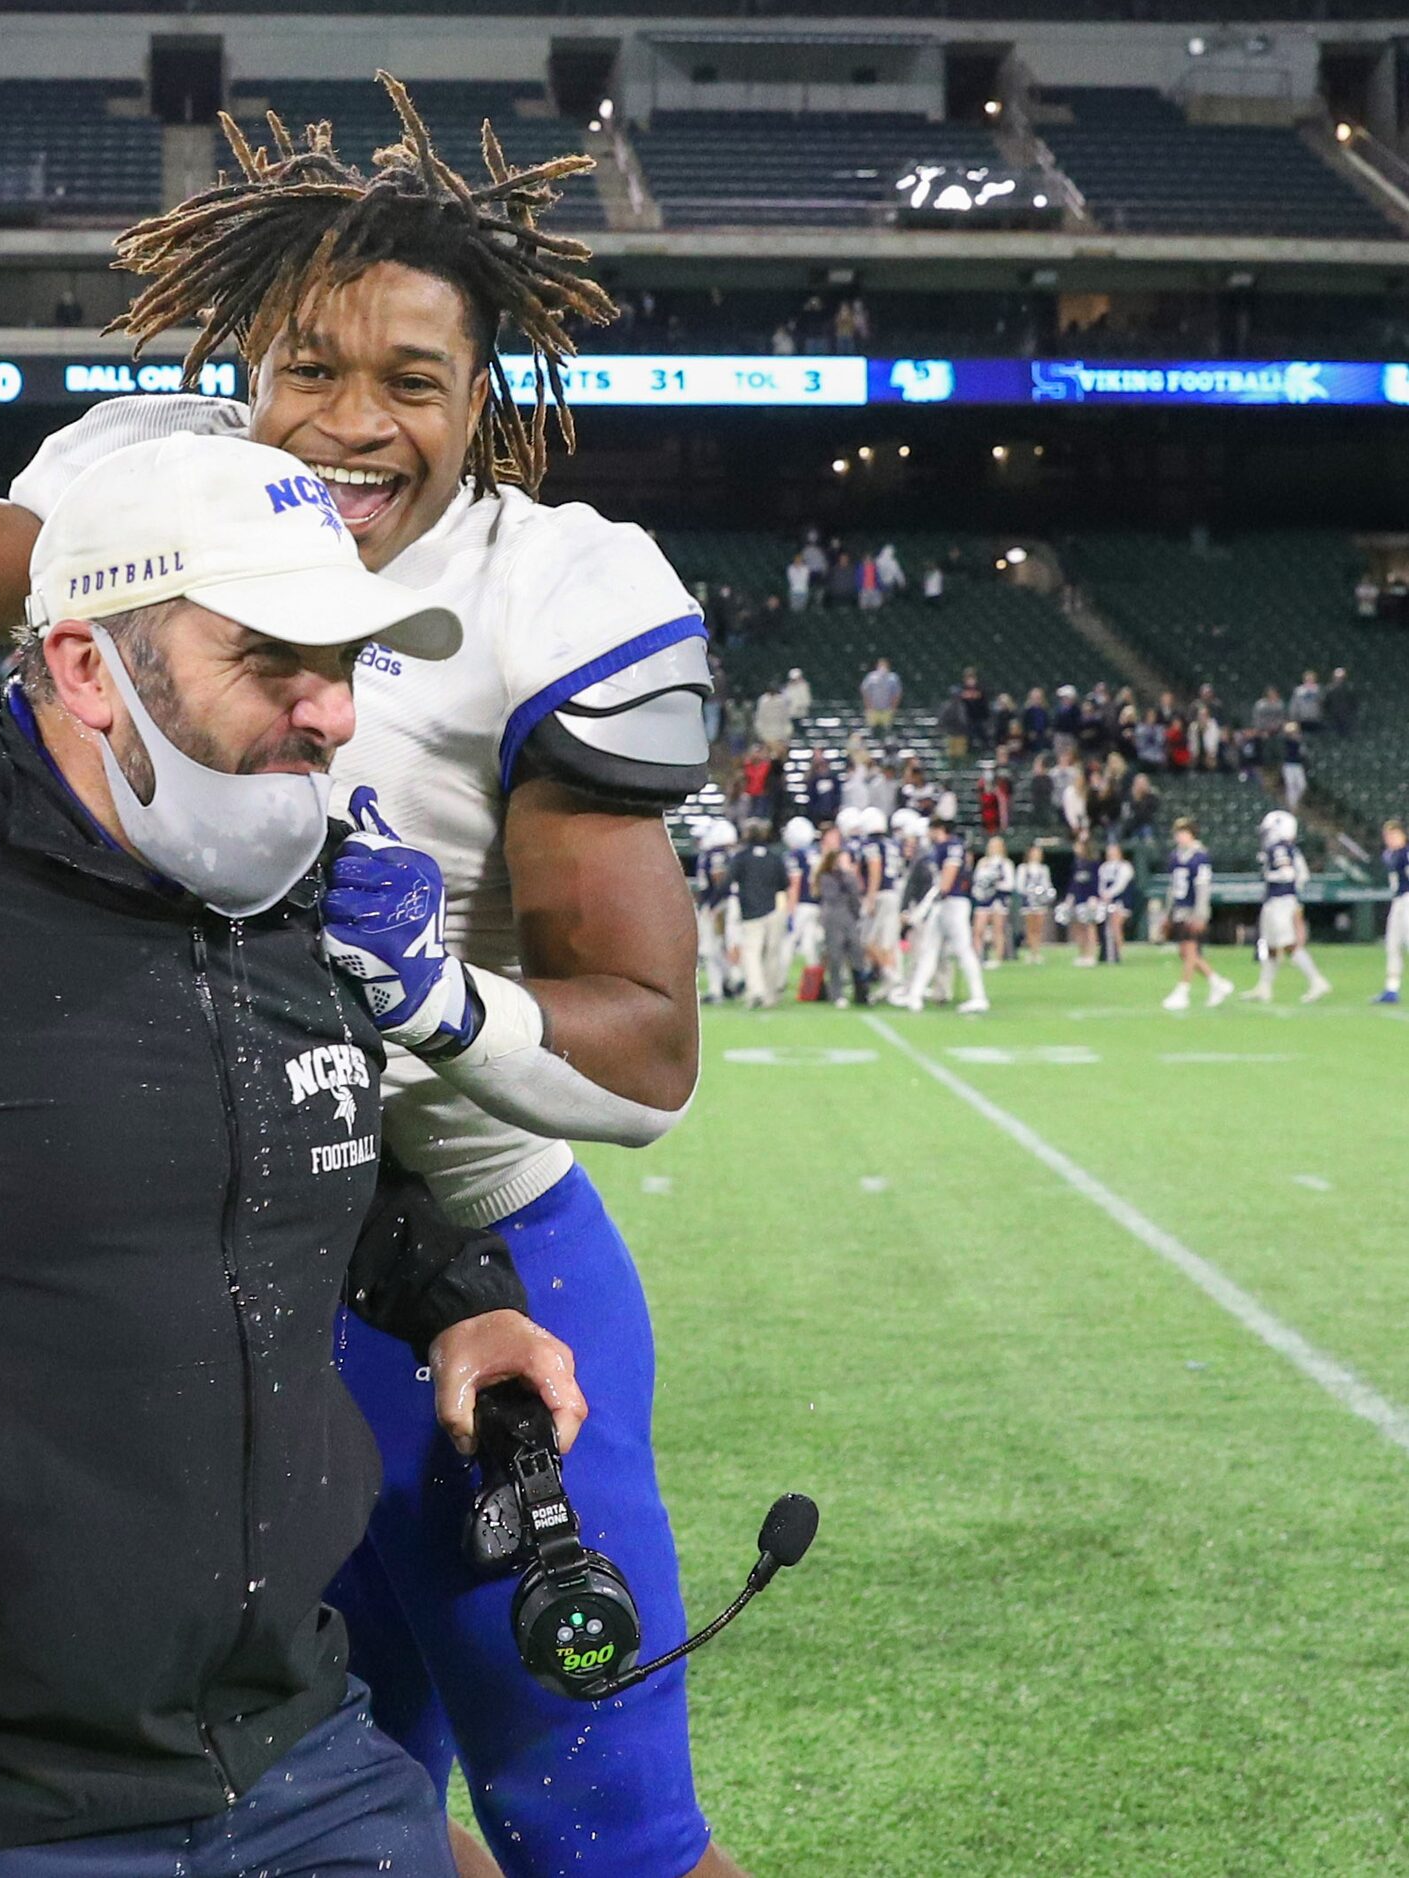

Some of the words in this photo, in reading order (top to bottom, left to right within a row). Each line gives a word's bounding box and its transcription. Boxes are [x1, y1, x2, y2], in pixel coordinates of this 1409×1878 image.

[65, 365, 136, 392] BALL
[199, 363, 236, 396] 11
[504, 371, 611, 389] SANTS
[649, 369, 687, 391] 31
[803, 369, 822, 392] 3
[1079, 370, 1165, 392] VIKING
[1166, 370, 1288, 392] FOOTBALL
[265, 476, 336, 514] NCH
[70, 551, 185, 600] FOOTBALL
[359, 649, 402, 676] das
[285, 1044, 370, 1105] NCHS
[310, 1134, 376, 1174] FOOTBALL
[532, 1503, 567, 1520] PORTA
[534, 1512, 569, 1530] PHONE
[555, 1647, 575, 1658] TD
[562, 1644, 615, 1671] 900
